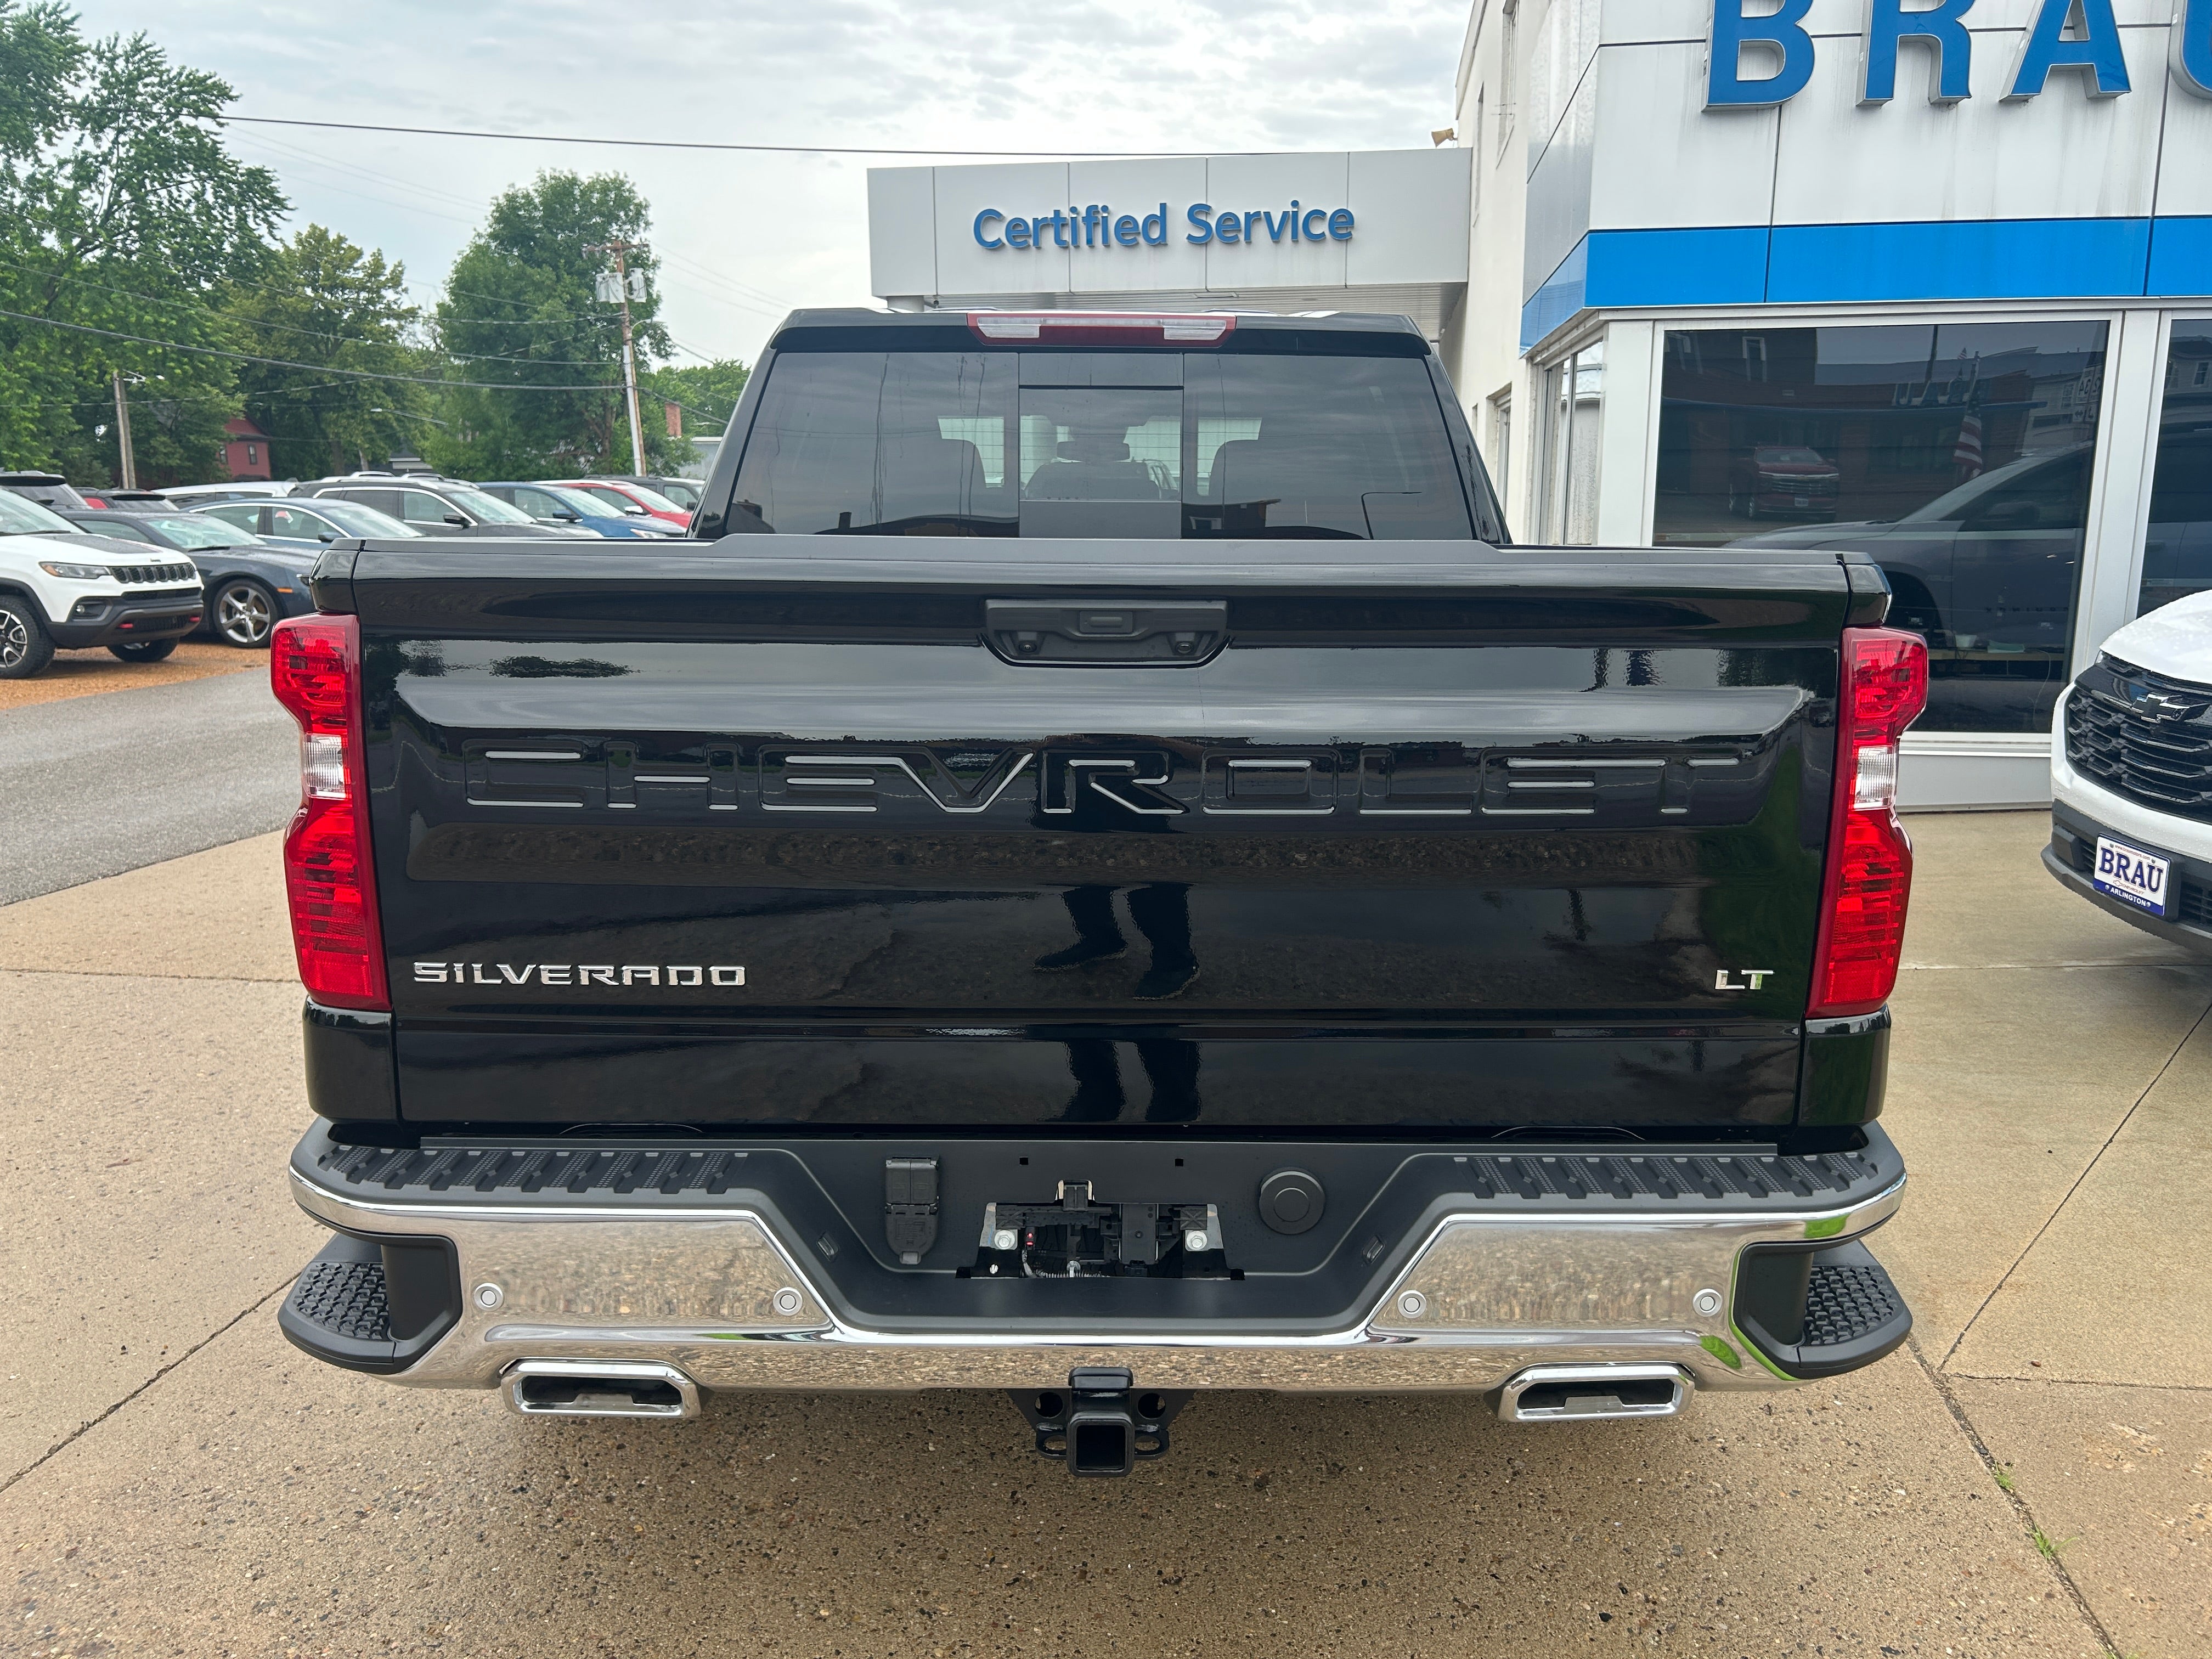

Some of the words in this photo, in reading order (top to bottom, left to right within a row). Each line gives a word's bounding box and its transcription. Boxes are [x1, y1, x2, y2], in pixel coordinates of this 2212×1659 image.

[973, 202, 1169, 249] Certified
[1186, 200, 1355, 244] Service
[462, 738, 1743, 816] CHEVROLET
[2098, 845, 2164, 894] BRAU
[2110, 887, 2146, 906] ARLINGTON
[413, 961, 746, 986] SILVERADO
[1715, 969, 1774, 990] LT
